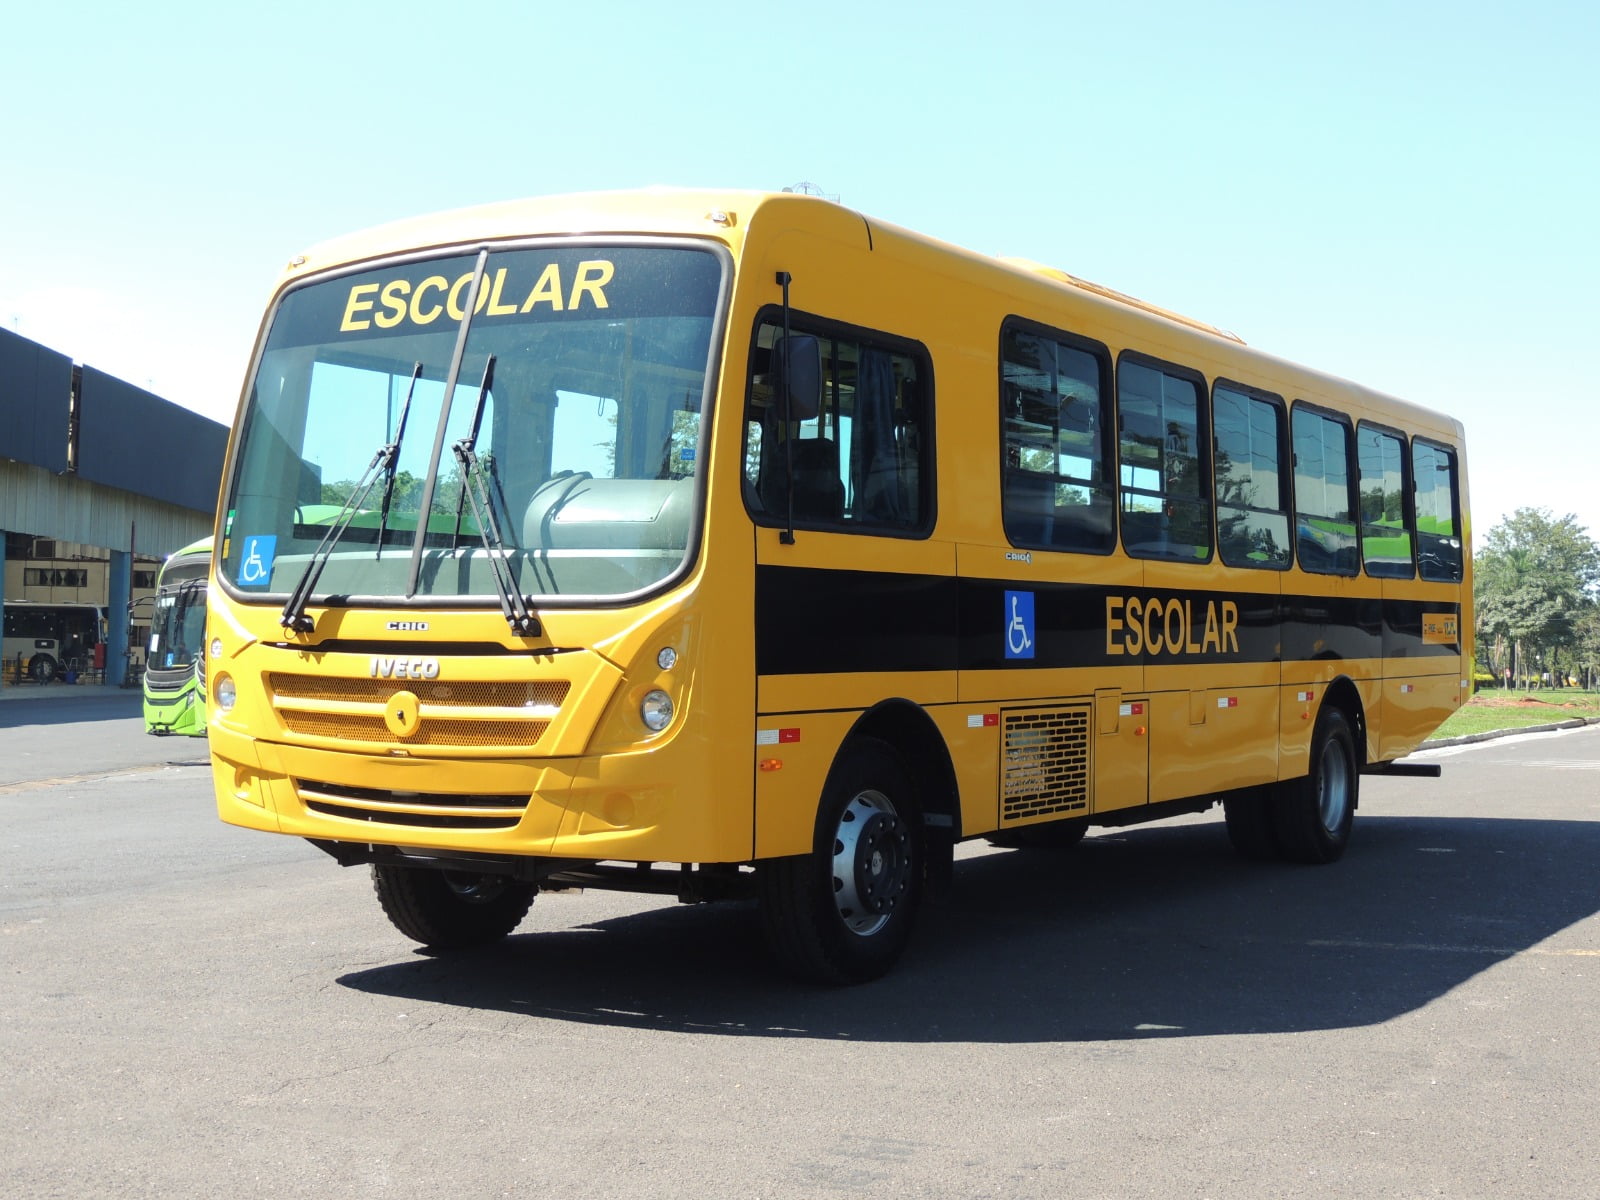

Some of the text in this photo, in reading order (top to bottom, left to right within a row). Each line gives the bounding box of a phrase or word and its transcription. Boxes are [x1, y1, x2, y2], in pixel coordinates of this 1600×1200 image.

[340, 260, 615, 332] ESCOLAR
[1005, 552, 1026, 561] CAIO
[386, 622, 429, 631] CAIO
[1106, 596, 1239, 656] ESCOLAR
[370, 655, 440, 679] IVECO
